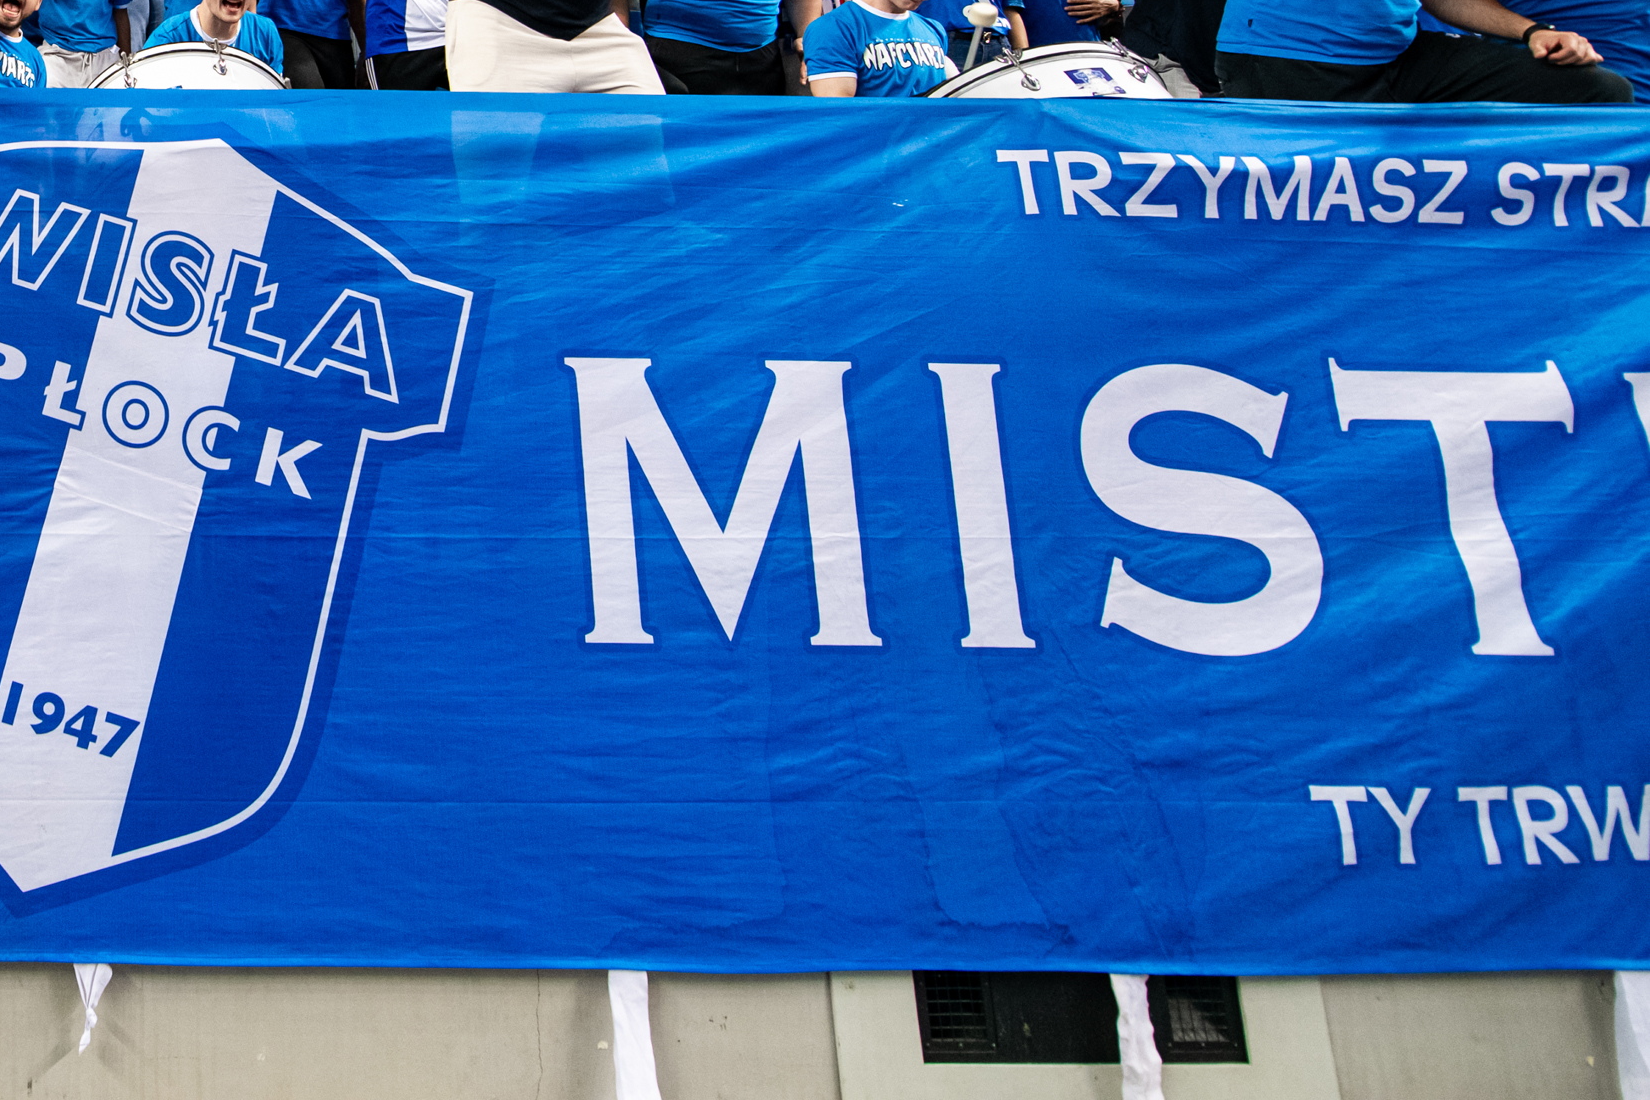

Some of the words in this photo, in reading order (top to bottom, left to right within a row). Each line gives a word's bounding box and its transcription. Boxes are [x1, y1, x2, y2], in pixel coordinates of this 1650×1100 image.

[864, 41, 945, 71] NAFCIARZ
[996, 148, 1473, 225] TRZYMASZ
[563, 357, 1650, 657] MIST
[1, 681, 141, 759] 1947
[1309, 785, 1431, 866] TY
